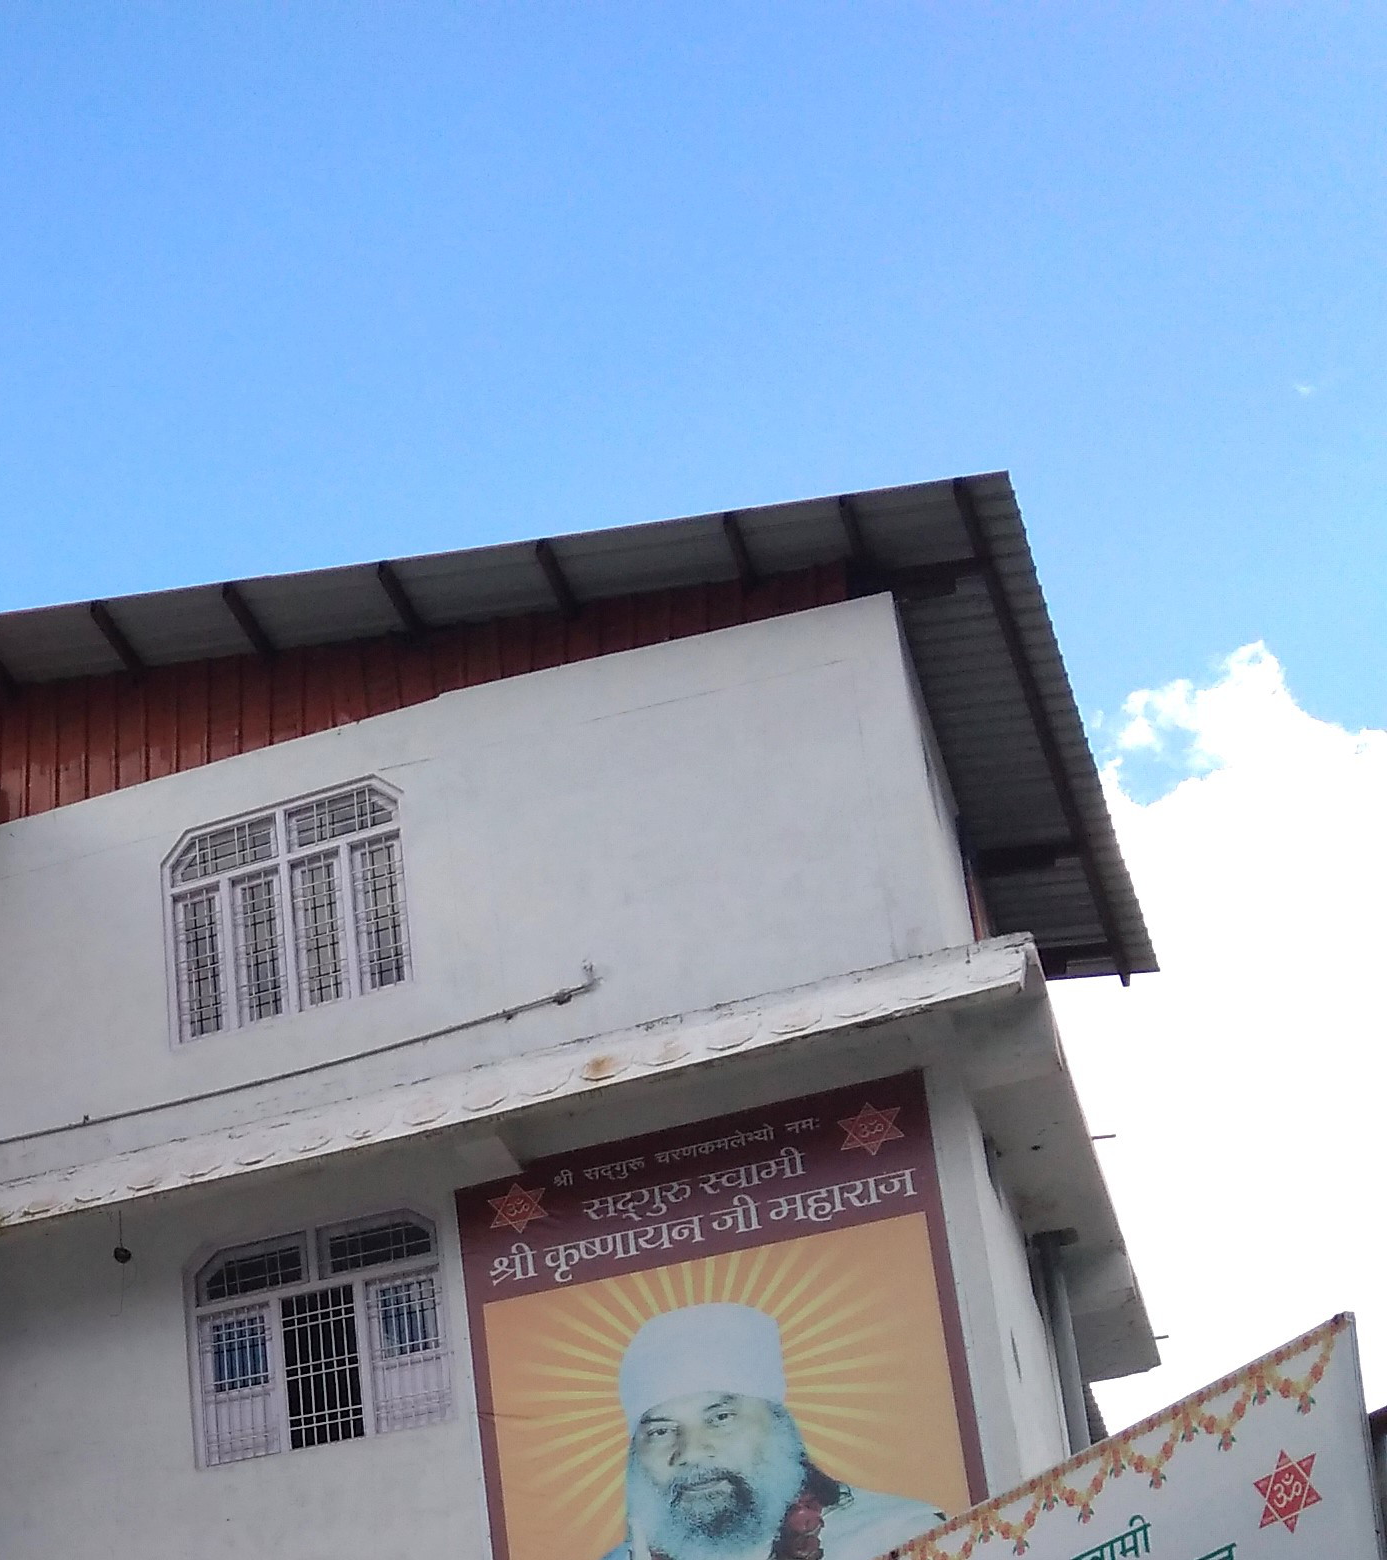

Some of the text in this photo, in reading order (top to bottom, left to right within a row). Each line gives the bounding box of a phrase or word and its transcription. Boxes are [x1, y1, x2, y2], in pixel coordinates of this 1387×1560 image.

[553, 1170, 574, 1187] श्री
[582, 1147, 806, 1222] सद्गुरु स्वामी
[489, 1168, 919, 1287] श्री कृष्णायन जी महाराज
